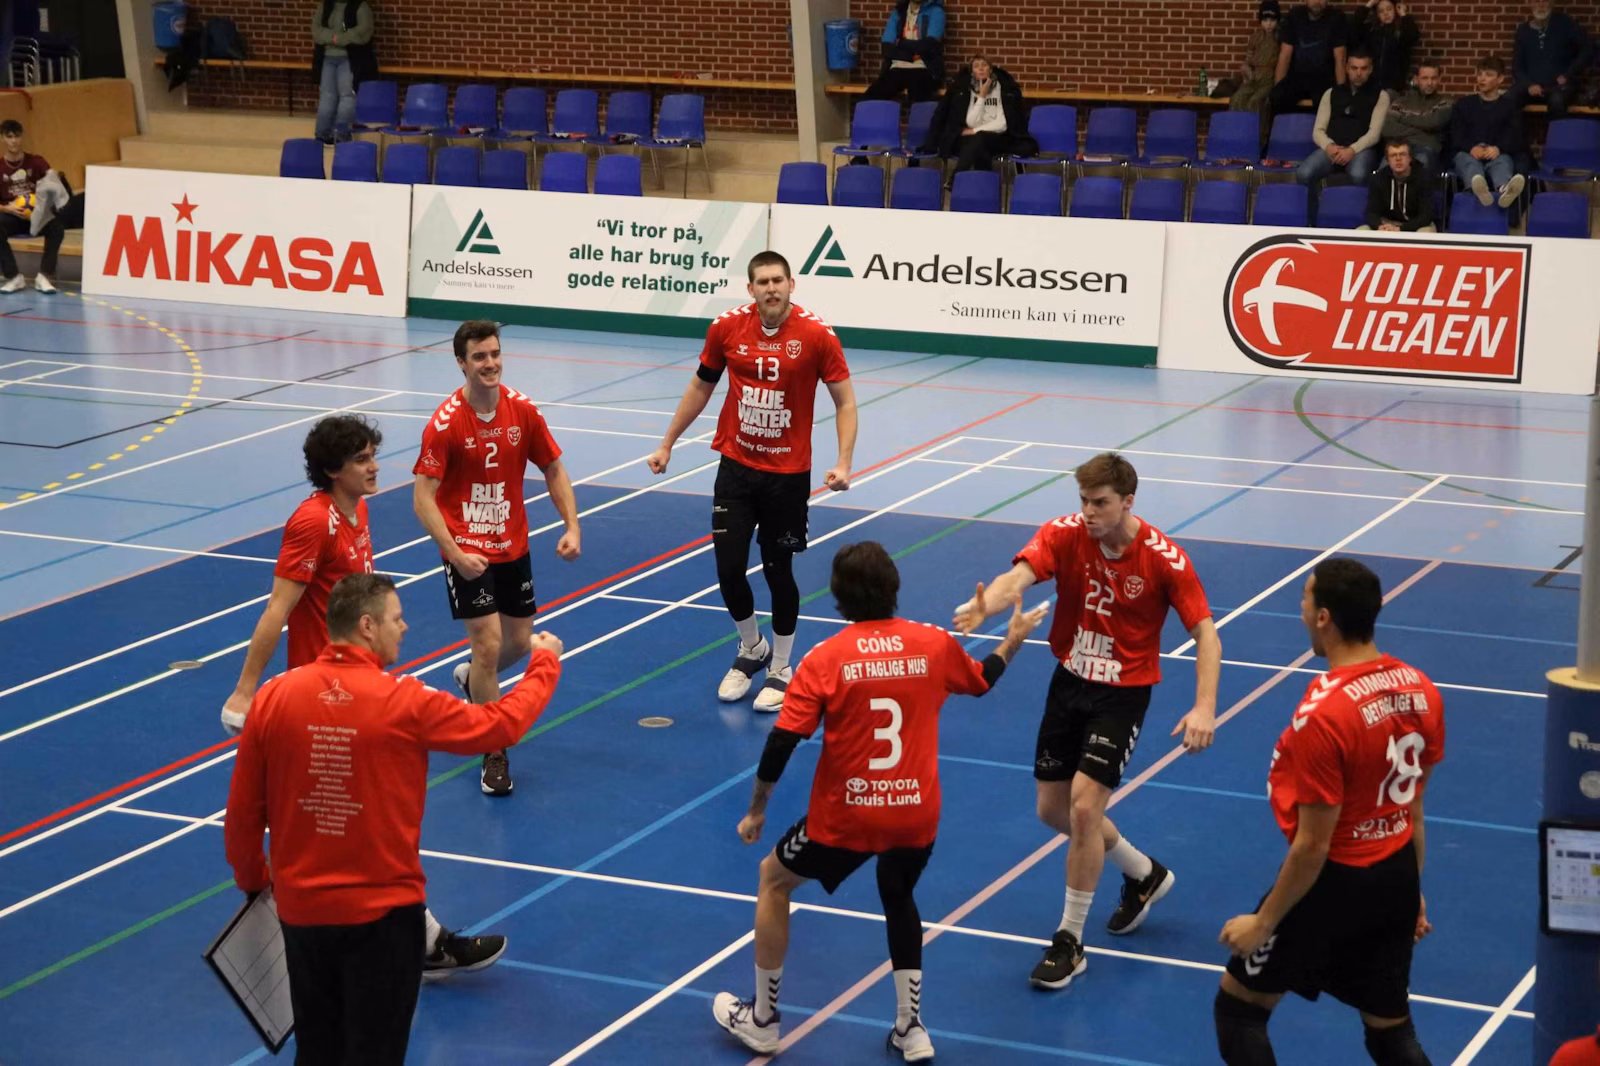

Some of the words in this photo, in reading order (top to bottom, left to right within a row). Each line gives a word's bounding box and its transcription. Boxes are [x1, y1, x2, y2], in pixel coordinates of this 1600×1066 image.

[631, 221, 667, 239] tror
[673, 222, 703, 244] på,
[102, 214, 384, 296] MIKASA
[569, 243, 604, 261] alle
[611, 246, 643, 263] har
[649, 248, 694, 270] brug
[701, 251, 730, 269] for
[422, 259, 533, 279] Andelskassen
[862, 253, 1128, 293] Andelskassen
[442, 279, 472, 288] Sammen
[474, 279, 487, 289] kan
[567, 271, 615, 289] gode
[622, 274, 728, 294] relationer”
[1340, 260, 1514, 309] VOLLEY
[950, 301, 1021, 320] Sammen
[1027, 306, 1056, 322] kan
[1062, 309, 1077, 324] vi
[1082, 314, 1125, 326] mere
[1332, 308, 1509, 358] LIGAEN
[755, 357, 780, 382] 13
[742, 385, 785, 410] BLUE
[737, 400, 792, 428] WATER
[740, 422, 782, 438] SHIPPING
[485, 442, 499, 469] 2
[756, 445, 791, 454] Gruppen
[470, 481, 506, 503] BLUE
[461, 500, 511, 524] WATER
[1084, 579, 1115, 617] 22
[856, 635, 904, 654] CONS
[843, 663, 863, 681] DET
[865, 659, 905, 678] FAGLIGE
[907, 658, 927, 675] HUS
[868, 697, 903, 770] 3
[1377, 731, 1426, 807] 18
[870, 779, 920, 791] TOYOTA
[845, 792, 885, 807] Louis
[887, 791, 922, 806] Lund
